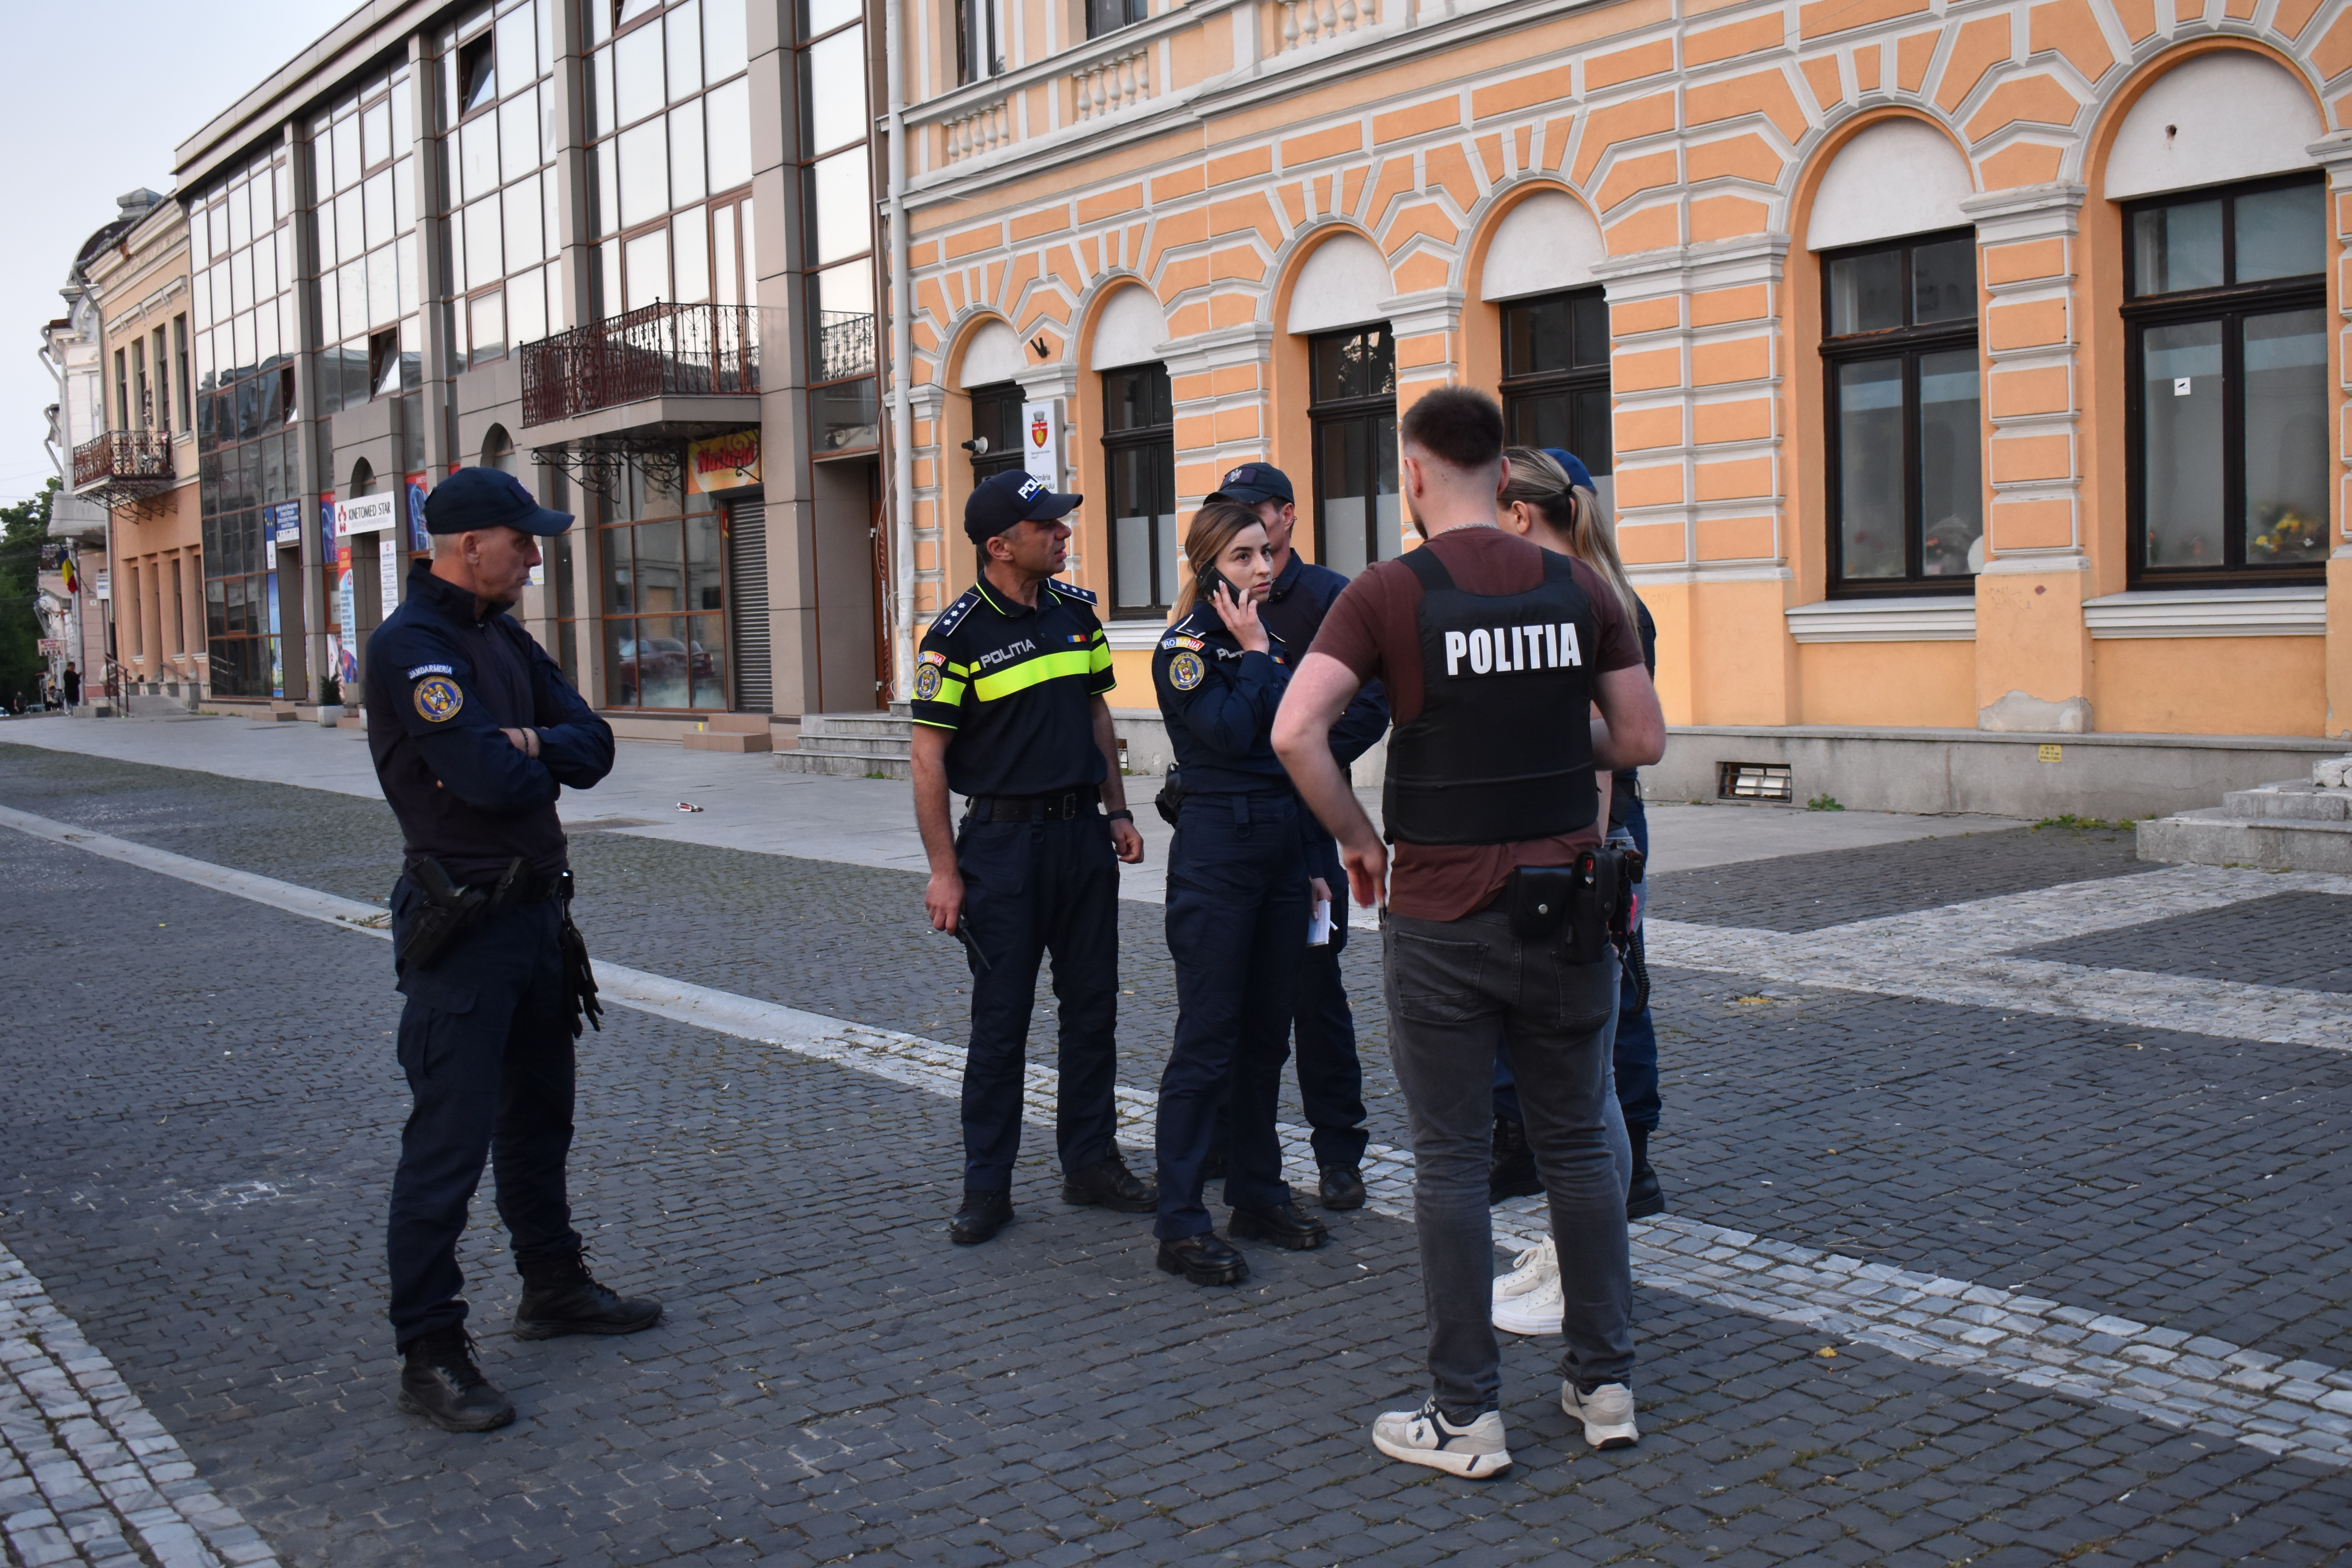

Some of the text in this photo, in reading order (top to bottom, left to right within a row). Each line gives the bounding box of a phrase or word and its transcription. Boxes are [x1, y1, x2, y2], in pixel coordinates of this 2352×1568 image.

[349, 502, 391, 520] KINETOMED STAR
[1164, 639, 1200, 650] ROMANIA
[1445, 623, 1582, 675] POLITIA
[918, 654, 942, 664] ROMANIA
[980, 639, 1036, 668] POLITIA
[410, 664, 452, 679] JANDARMERIA
